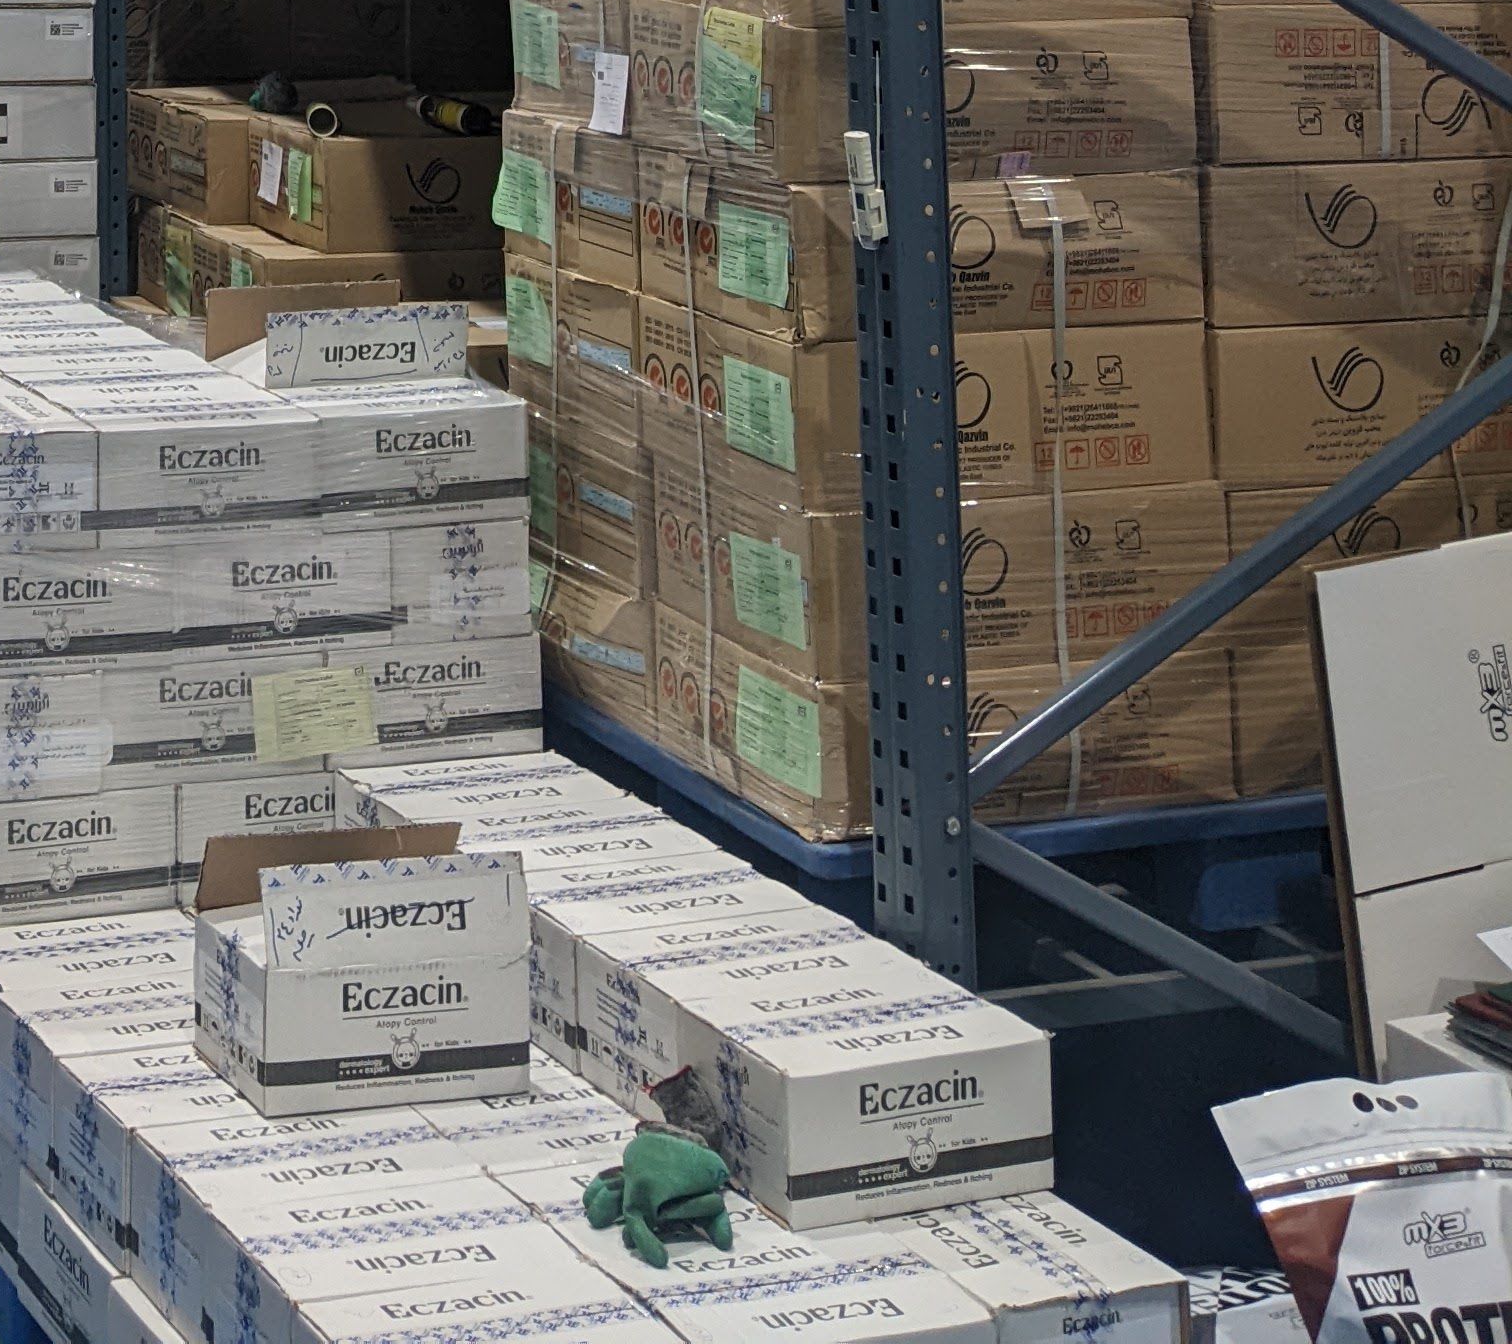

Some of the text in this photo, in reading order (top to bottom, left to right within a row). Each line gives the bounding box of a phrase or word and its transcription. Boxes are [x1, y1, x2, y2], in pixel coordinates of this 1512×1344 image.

[959, 271, 990, 283] Qazvin
[320, 341, 416, 369] Eczacin
[376, 423, 474, 453] Eczacin
[958, 431, 988, 443] Qazvin
[964, 444, 1001, 453] Industrial
[159, 441, 265, 470] Eczacin
[232, 555, 337, 587] Eczacin
[3, 573, 111, 602] Eczacin
[378, 655, 485, 687] Eczacin
[159, 672, 252, 703] Eczaci
[403, 762, 514, 778] Eczacin
[245, 786, 335, 819] Eczaci
[449, 786, 562, 805] Eczacin
[7, 810, 117, 845] Eczacin
[477, 805, 593, 827] Eczacin
[533, 837, 654, 858] Eczacin
[560, 862, 679, 883] Eczacin
[339, 898, 467, 939] Eczacin
[618, 893, 743, 916] Eczacin
[14, 919, 132, 941] Eczacin
[657, 922, 783, 947] Eczacin
[56, 952, 177, 974] Eczacin
[719, 954, 850, 981] Eczacin
[59, 980, 184, 1002] Eczacin
[342, 974, 469, 1012] Eczacin
[750, 986, 883, 1013] Eczacin
[376, 1015, 437, 1029] Atopy Control
[826, 1025, 965, 1052] Eczacin
[858, 1070, 984, 1116] Eczacin
[209, 1116, 346, 1142] Eczacin
[893, 1114, 953, 1131] Atopy Control
[261, 1157, 405, 1185] Eczacin
[286, 1197, 433, 1225] Eczacin
[1000, 1195, 1088, 1246] czacin
[43, 1214, 91, 1295] Eczacin
[902, 1212, 1000, 1270] Eczaci
[344, 1244, 497, 1273] Eczacin
[673, 1242, 819, 1275] Eczacin
[1354, 1271, 1415, 1304] 100%
[379, 1287, 533, 1319] Eczacin
[758, 1296, 904, 1331] Eczacin
